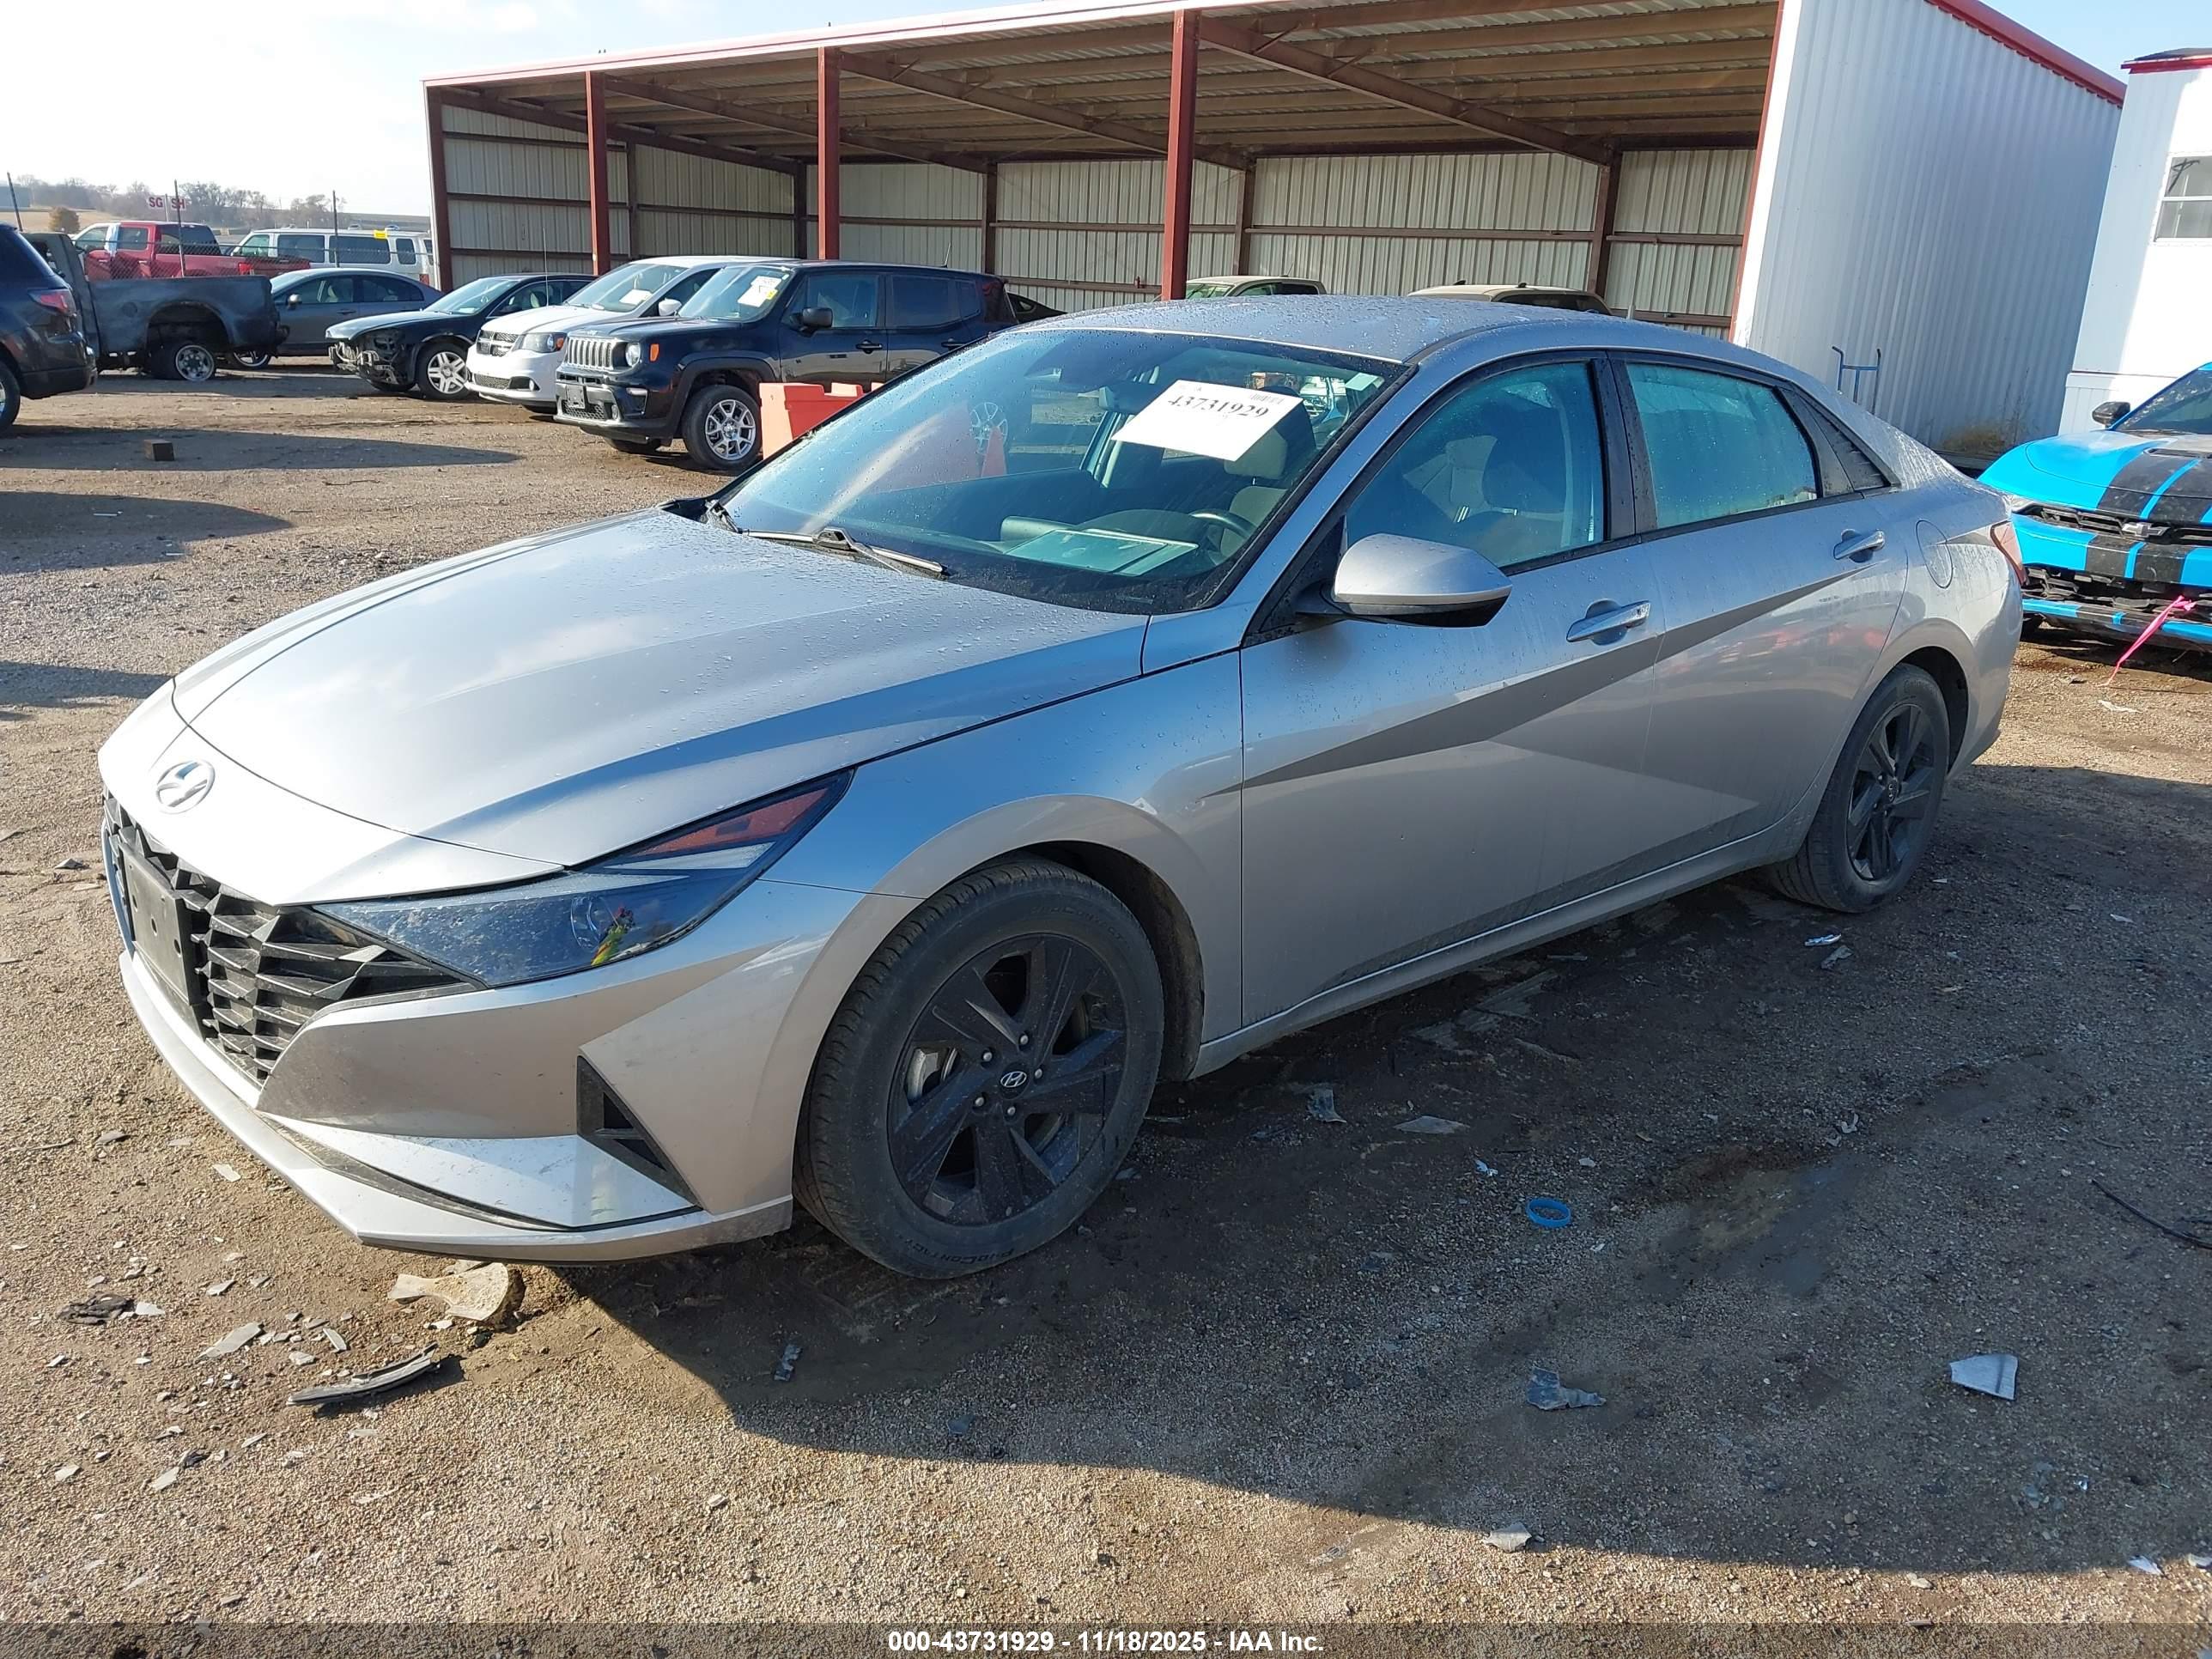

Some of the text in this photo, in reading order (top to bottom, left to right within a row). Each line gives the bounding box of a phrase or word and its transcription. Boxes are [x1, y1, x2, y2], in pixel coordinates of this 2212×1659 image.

[149, 197, 163, 208] SG
[171, 198, 185, 209] SH
[1168, 395, 1269, 418] 43731929
